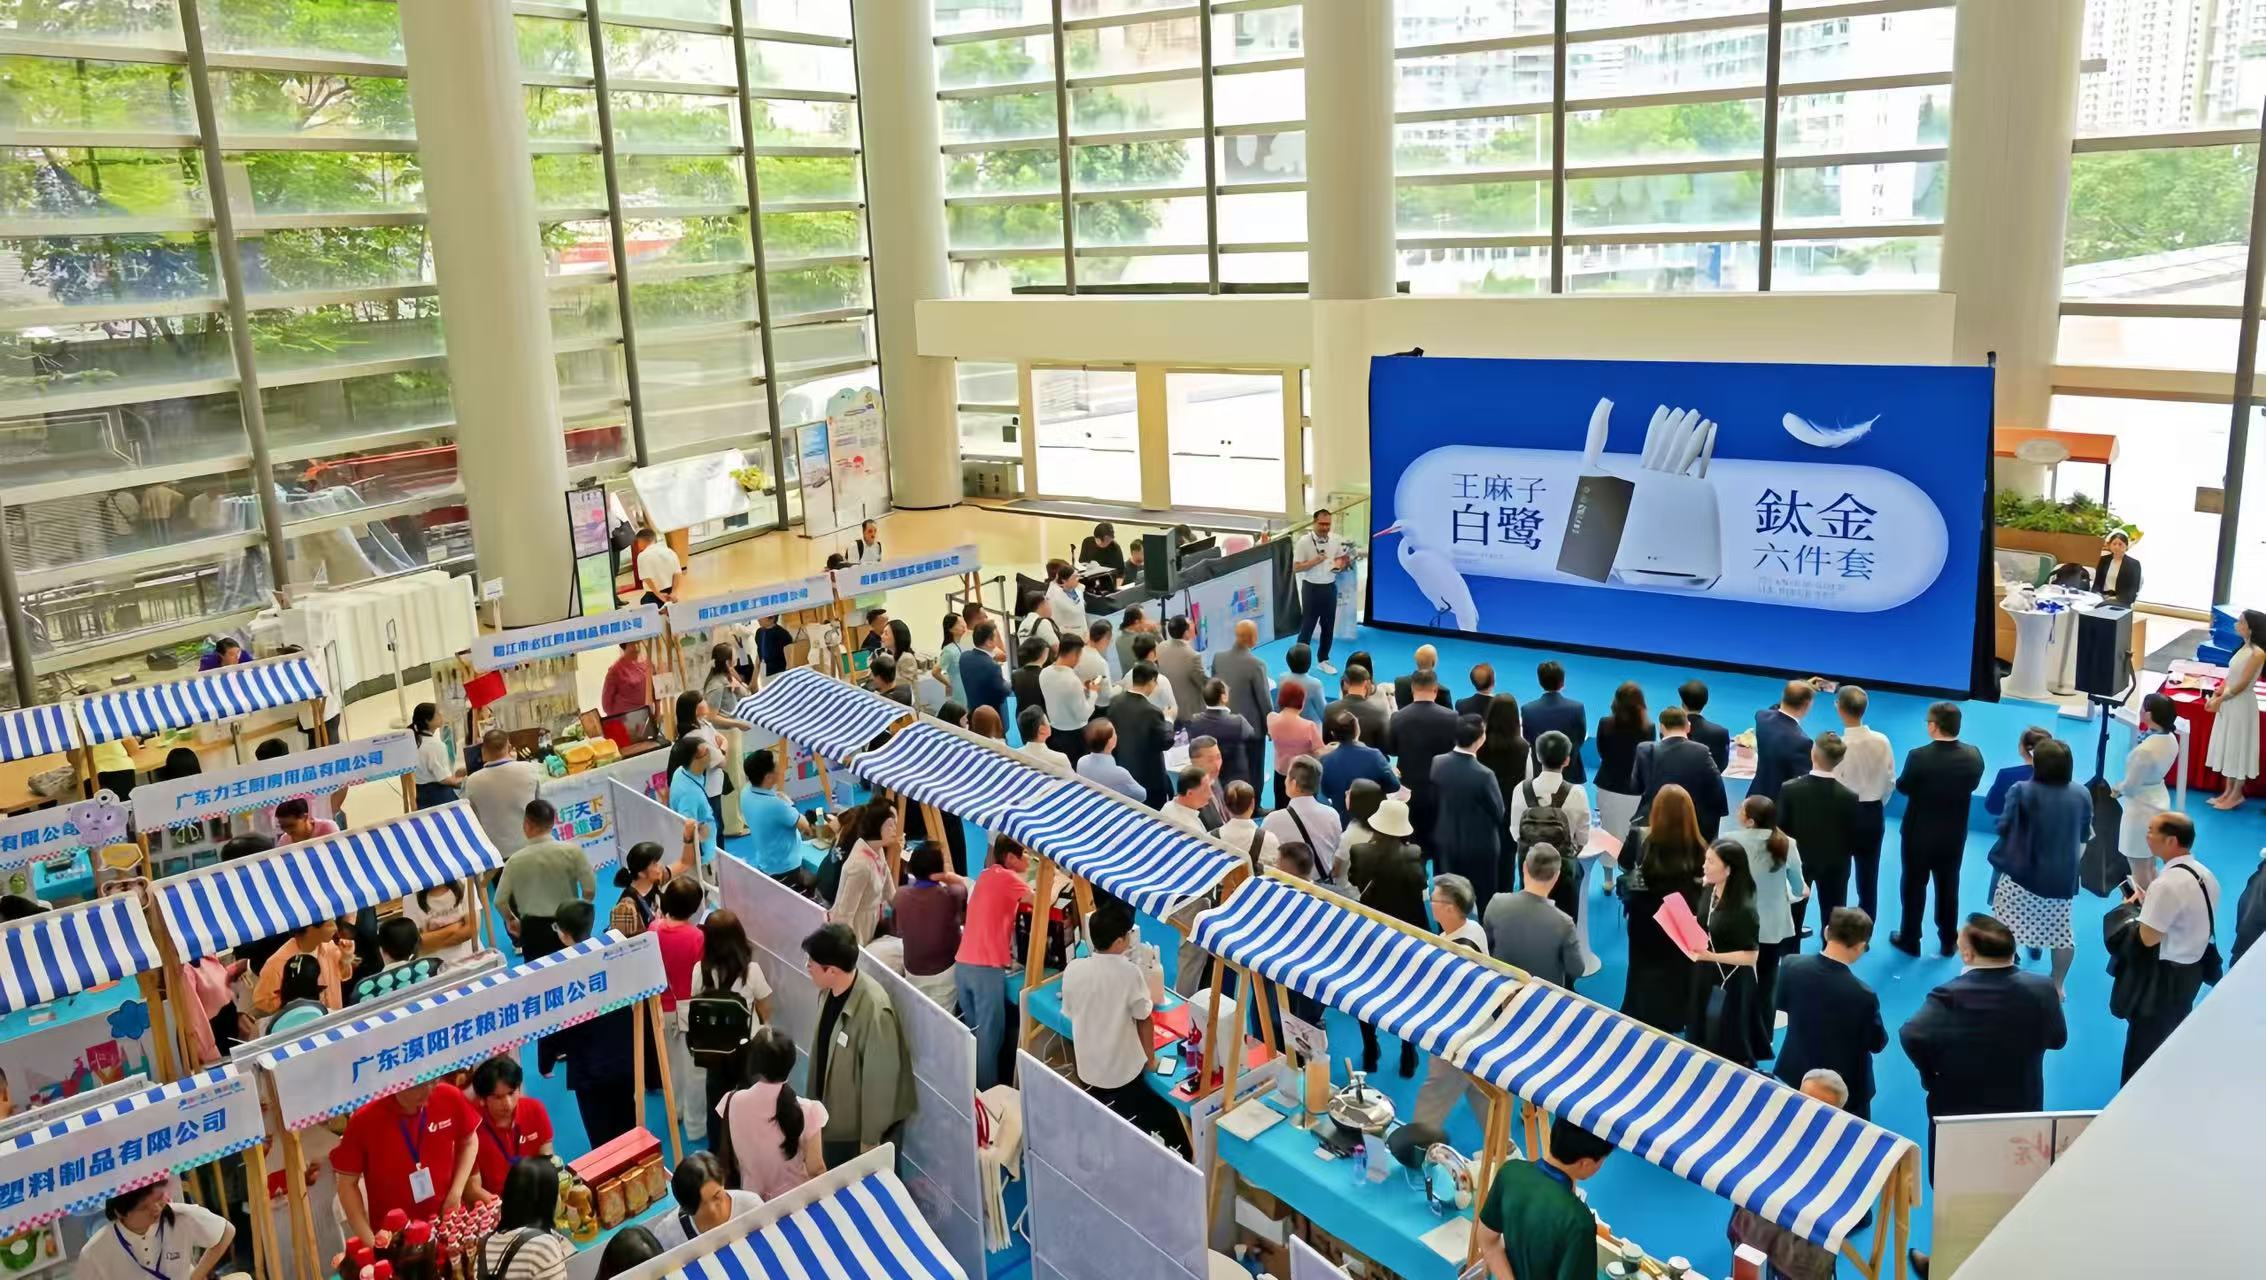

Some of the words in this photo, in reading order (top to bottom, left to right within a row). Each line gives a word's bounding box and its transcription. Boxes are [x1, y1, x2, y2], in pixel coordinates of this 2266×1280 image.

[1451, 473, 1547, 504] 王麻子
[1754, 487, 1878, 541] 鈦金
[1452, 503, 1545, 551] 白鹭
[1752, 541, 1875, 580] 六件套
[176, 750, 384, 810] 广东力王厨房用品有限公司
[351, 970, 609, 1083] 广东漠阳花粮油有限公司
[0, 1108, 227, 1211] 塑料制品有限公司
